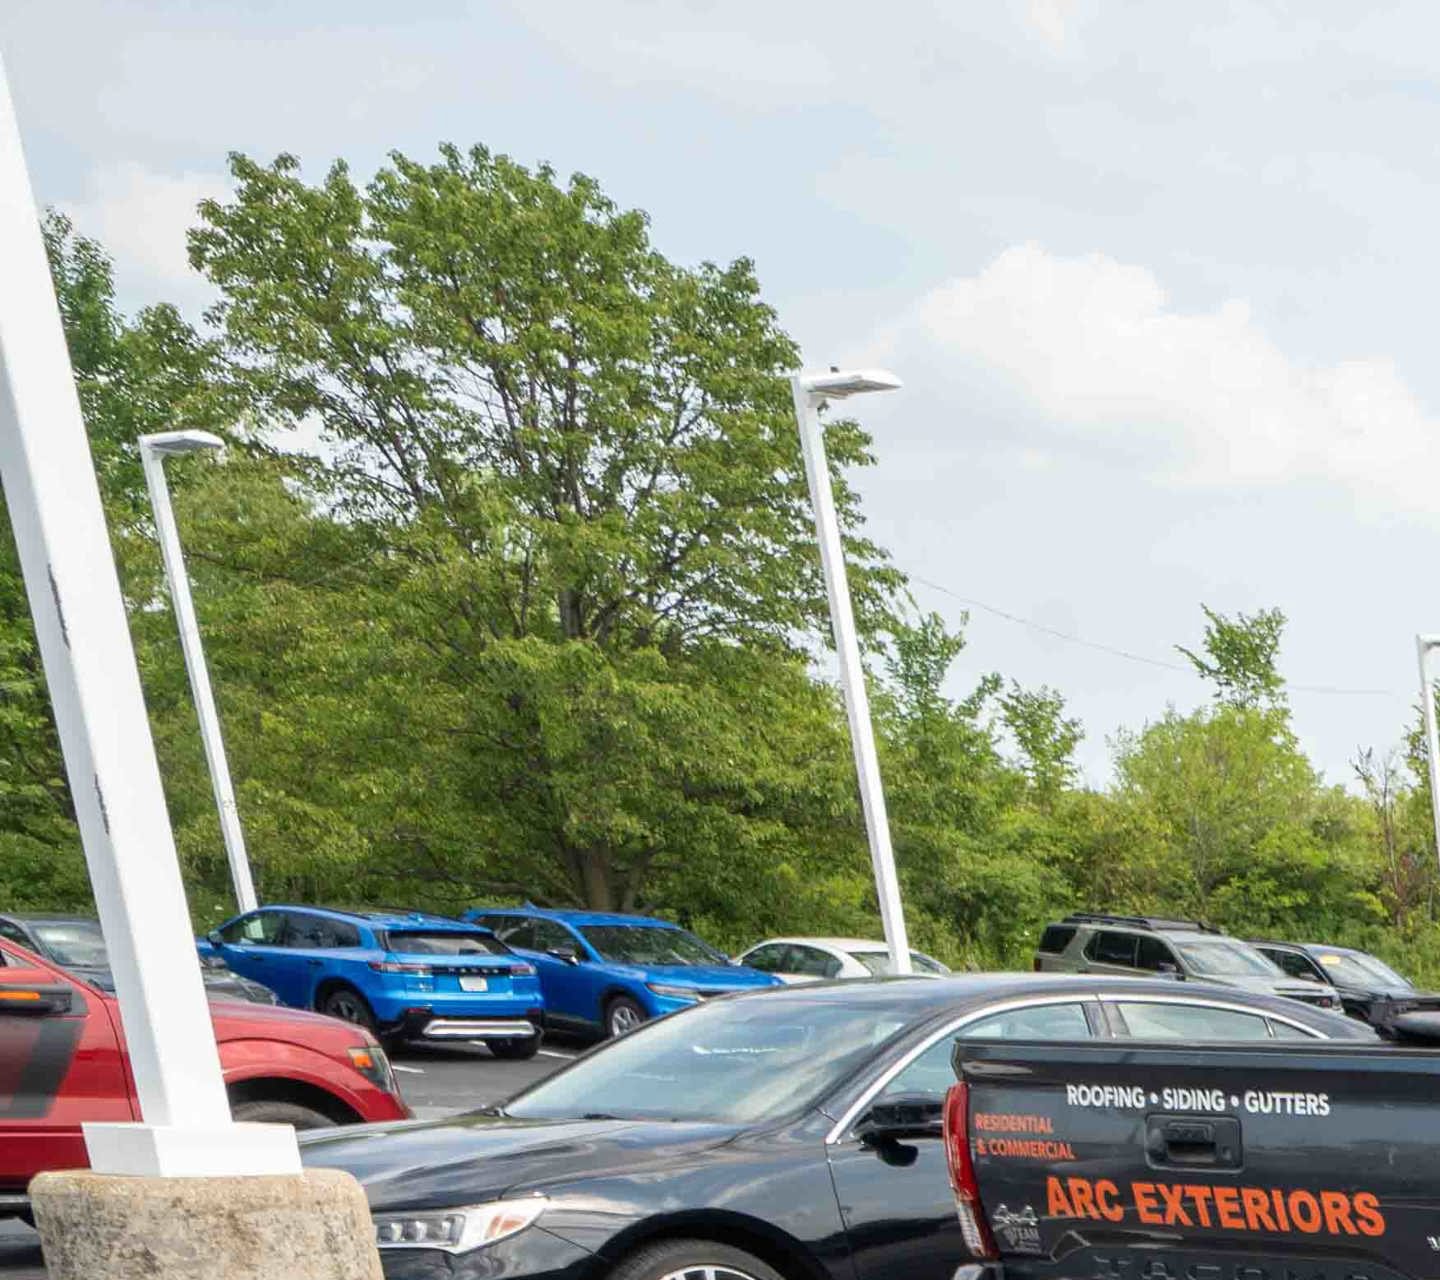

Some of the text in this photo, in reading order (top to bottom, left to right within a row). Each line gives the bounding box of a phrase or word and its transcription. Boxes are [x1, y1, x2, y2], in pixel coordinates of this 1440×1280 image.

[1066, 1084, 1331, 1117] ROOFING SIDING GUTTERS
[974, 1112, 1054, 1135] RESIDENTIAL
[976, 1138, 1077, 1160] & COMMERCIAL
[1046, 1175, 1387, 1237] ARC EXTERIORS
